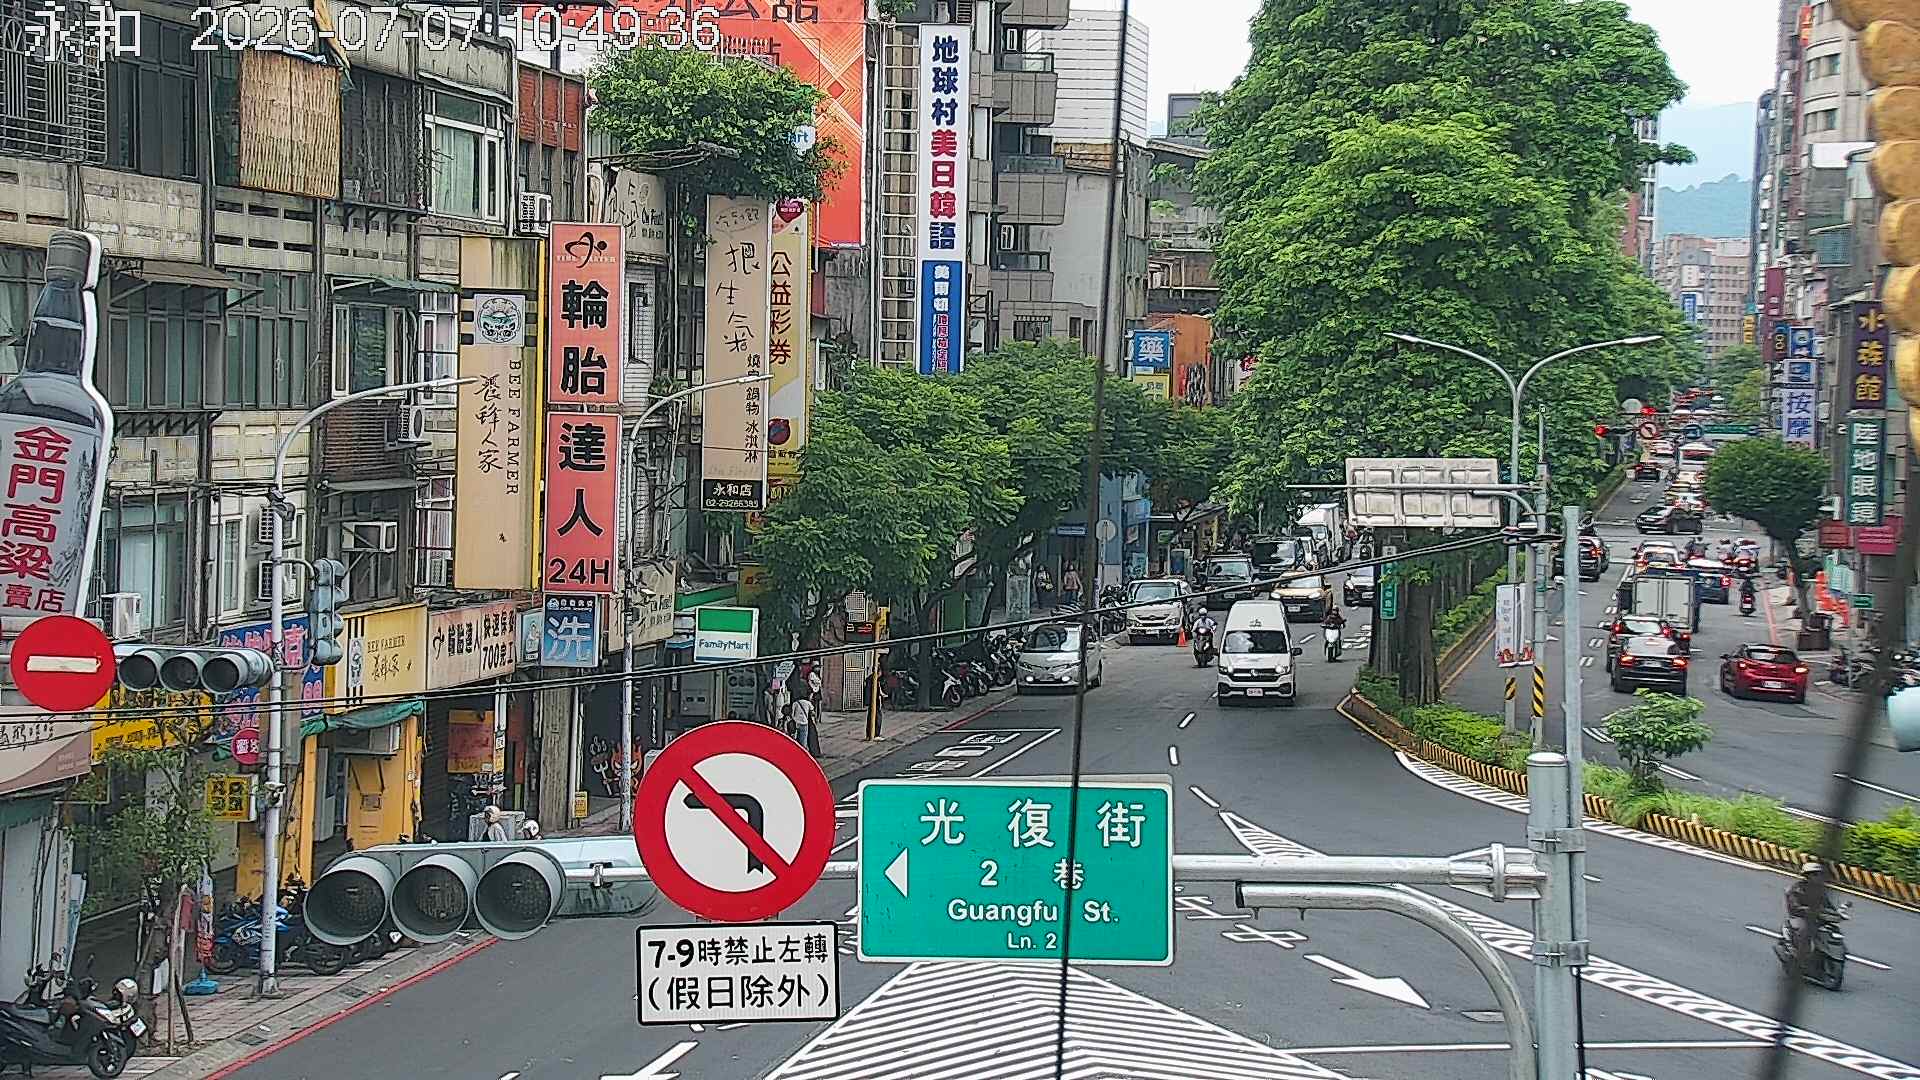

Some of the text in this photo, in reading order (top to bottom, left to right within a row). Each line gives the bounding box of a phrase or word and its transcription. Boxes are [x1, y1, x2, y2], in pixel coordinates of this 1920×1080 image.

[930, 35, 960, 250] 地球村美日韓語
[769, 250, 793, 366] 公益彩券
[561, 279, 609, 396] 輪胎
[1137, 335, 1165, 363] 藥
[474, 373, 504, 474] 養蜂人家
[506, 359, 521, 495] BEE FARMER
[1785, 390, 1813, 440] 按摩
[556, 422, 607, 537] 達人
[712, 482, 753, 497] 永和店
[0, 426, 72, 582] 金門高粱
[548, 557, 611, 585] 24H
[0, 584, 65, 613] 賣店
[547, 615, 592, 657] 洗
[698, 638, 750, 651] FamilyMart
[919, 797, 1146, 850] 光復街
[979, 859, 1085, 891] 2 巷
[947, 898, 1119, 926] Guangfu St.
[647, 933, 829, 968] 7-9時禁止左轉
[1007, 932, 1058, 950] Ln. 2
[648, 973, 830, 1011] (假日除外)
